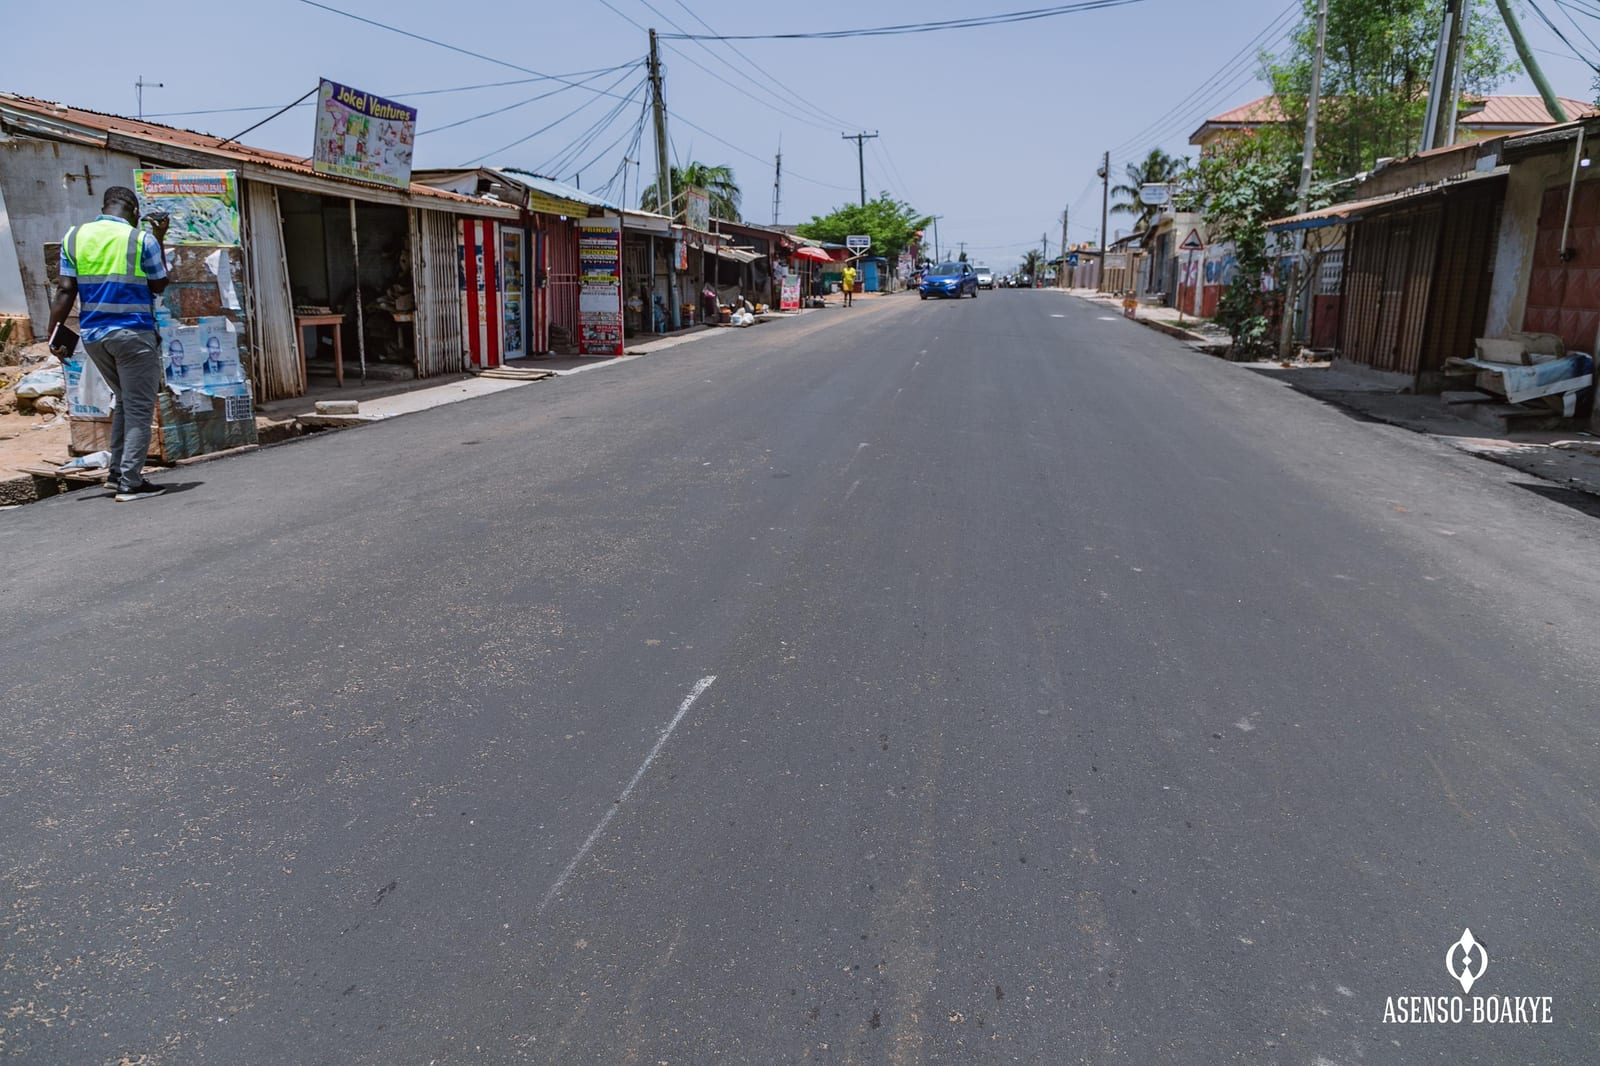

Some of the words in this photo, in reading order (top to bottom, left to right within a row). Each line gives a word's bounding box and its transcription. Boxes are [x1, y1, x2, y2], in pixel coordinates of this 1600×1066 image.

[337, 86, 367, 111] Jokel
[369, 95, 411, 120] Ventures
[177, 173, 221, 184] VENTURES
[159, 184, 175, 193] STORE
[194, 184, 227, 193] WHOLESALE
